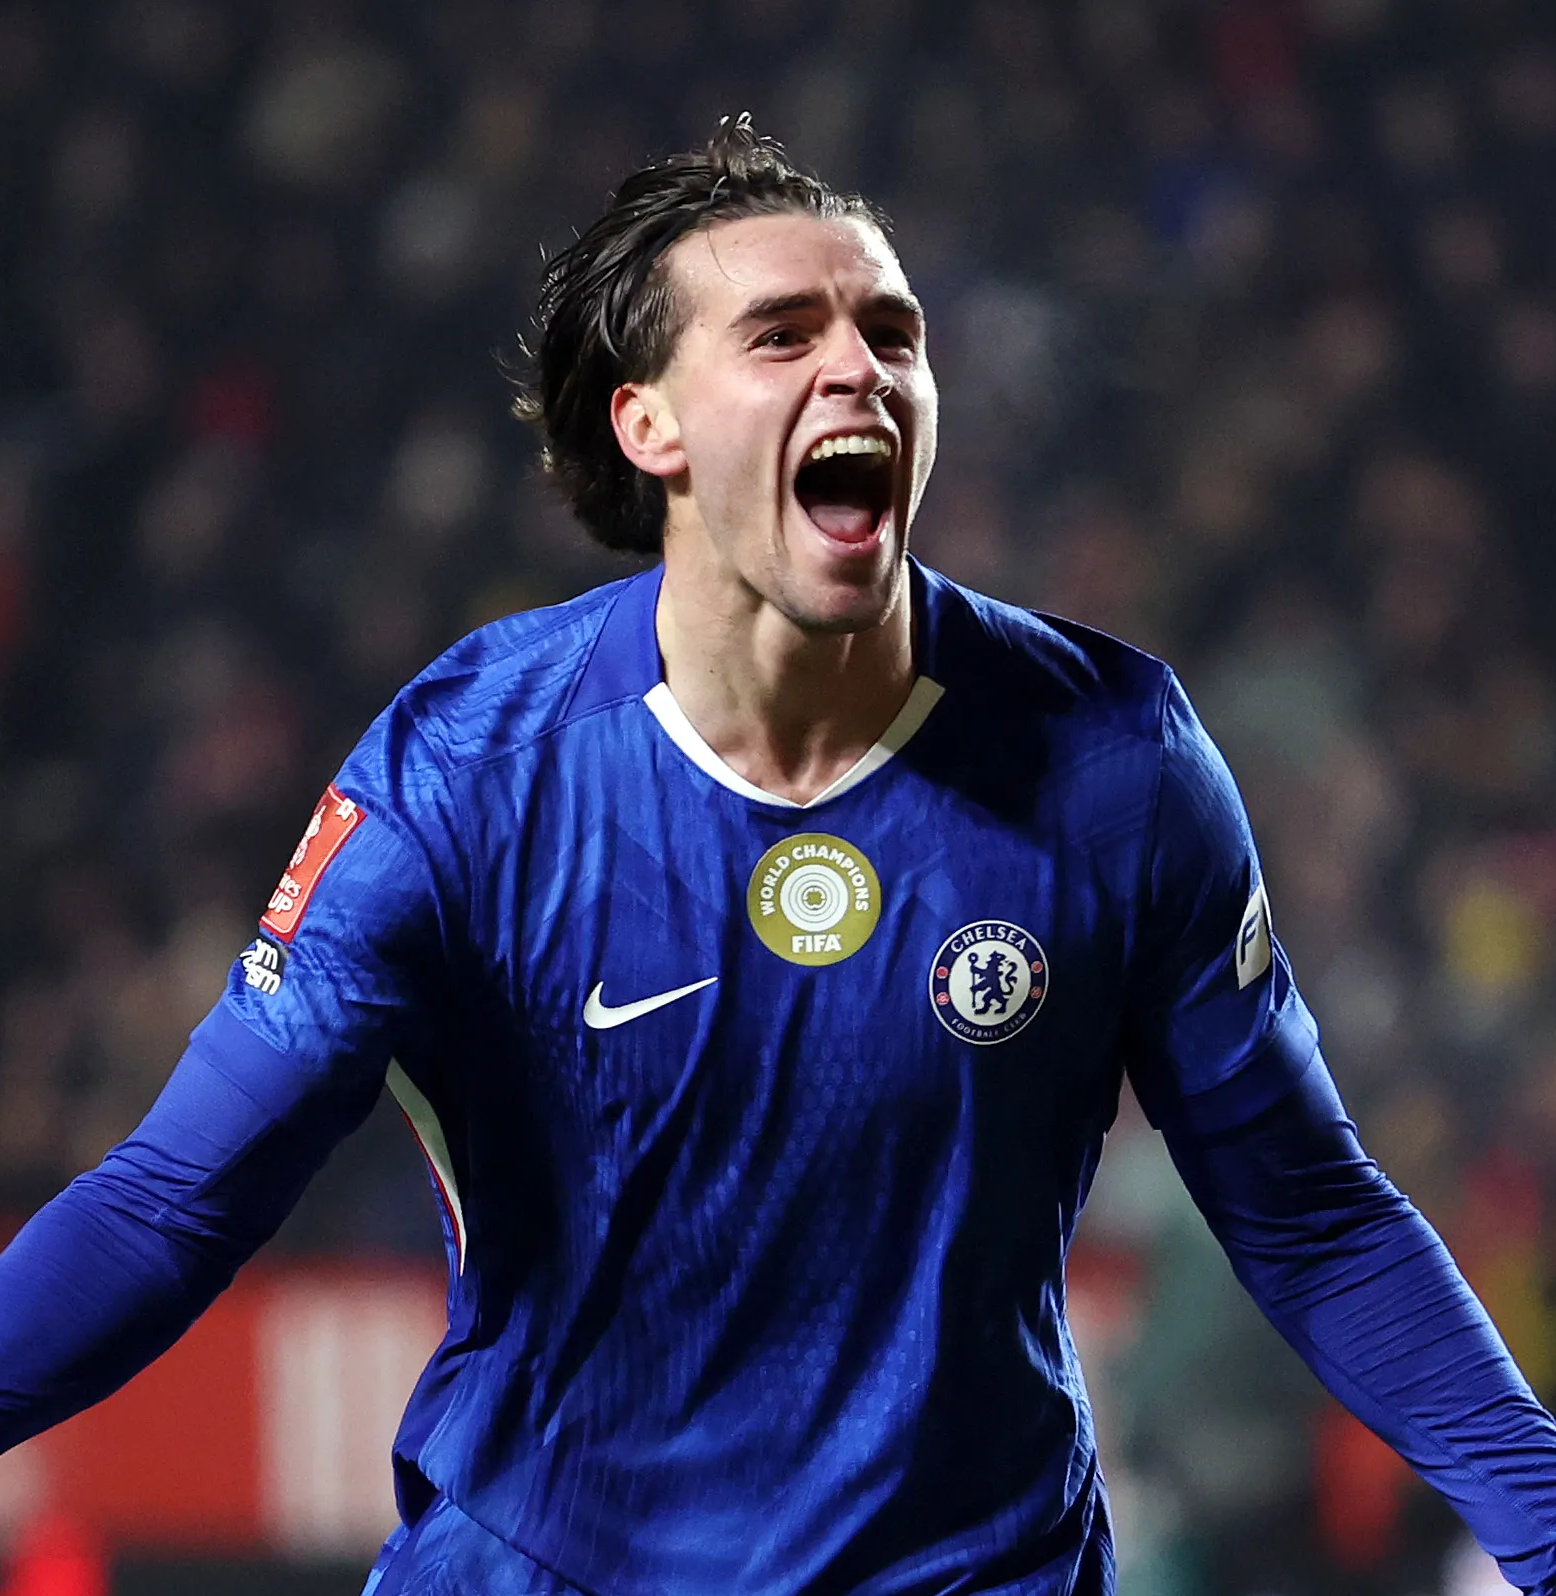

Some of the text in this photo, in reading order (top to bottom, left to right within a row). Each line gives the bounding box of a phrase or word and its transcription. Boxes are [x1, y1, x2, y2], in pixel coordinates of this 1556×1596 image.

[760, 844, 869, 916] WORLD CHAMPIONS
[268, 888, 293, 913] UP
[791, 934, 842, 953] FIFA
[951, 926, 1027, 953] CHELSEA
[951, 1018, 999, 1038] FOOTBALL
[1004, 1012, 1027, 1033] CLUB
